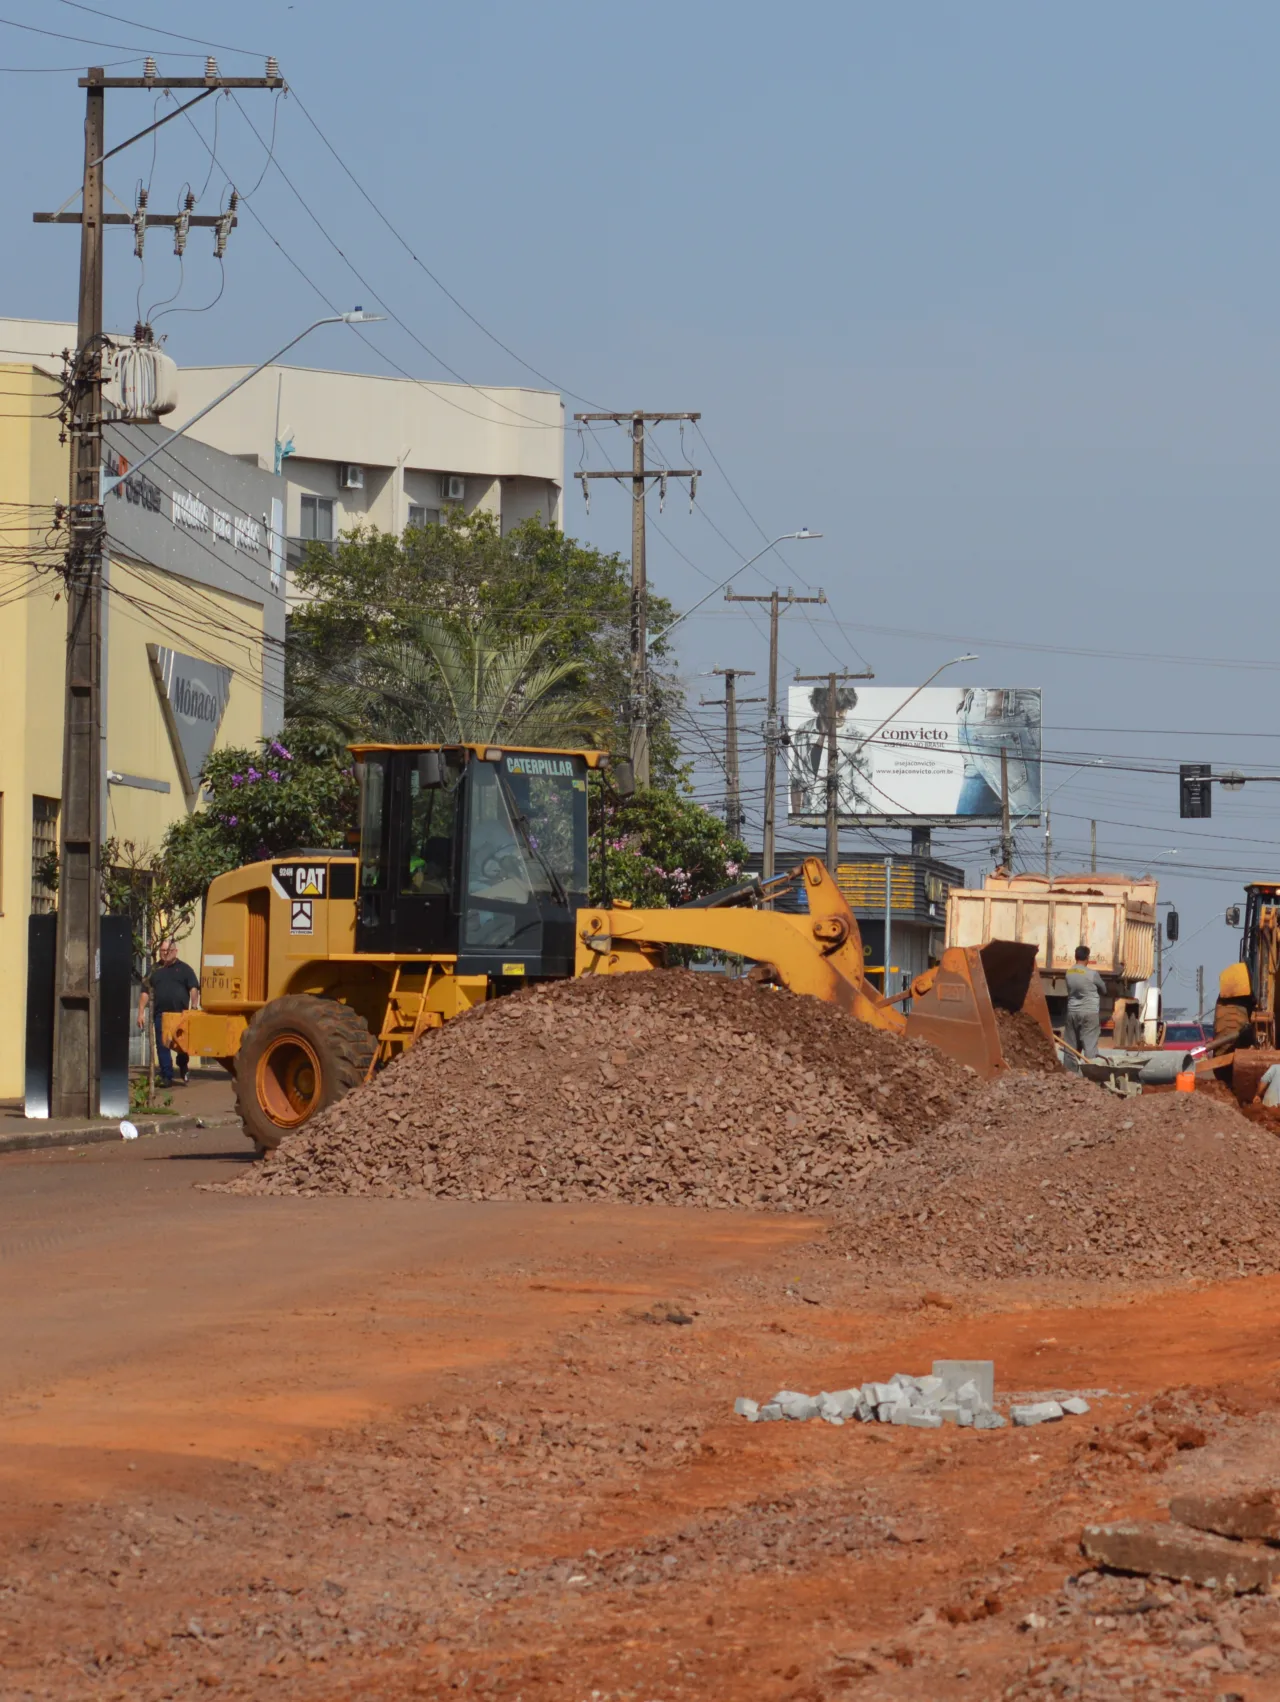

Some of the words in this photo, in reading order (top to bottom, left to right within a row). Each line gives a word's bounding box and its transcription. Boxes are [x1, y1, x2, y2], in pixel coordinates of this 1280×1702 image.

[174, 676, 217, 722] Mônaco
[881, 727, 948, 740] convicto
[506, 757, 574, 777] CATERPILLAR
[295, 867, 326, 895] CAT
